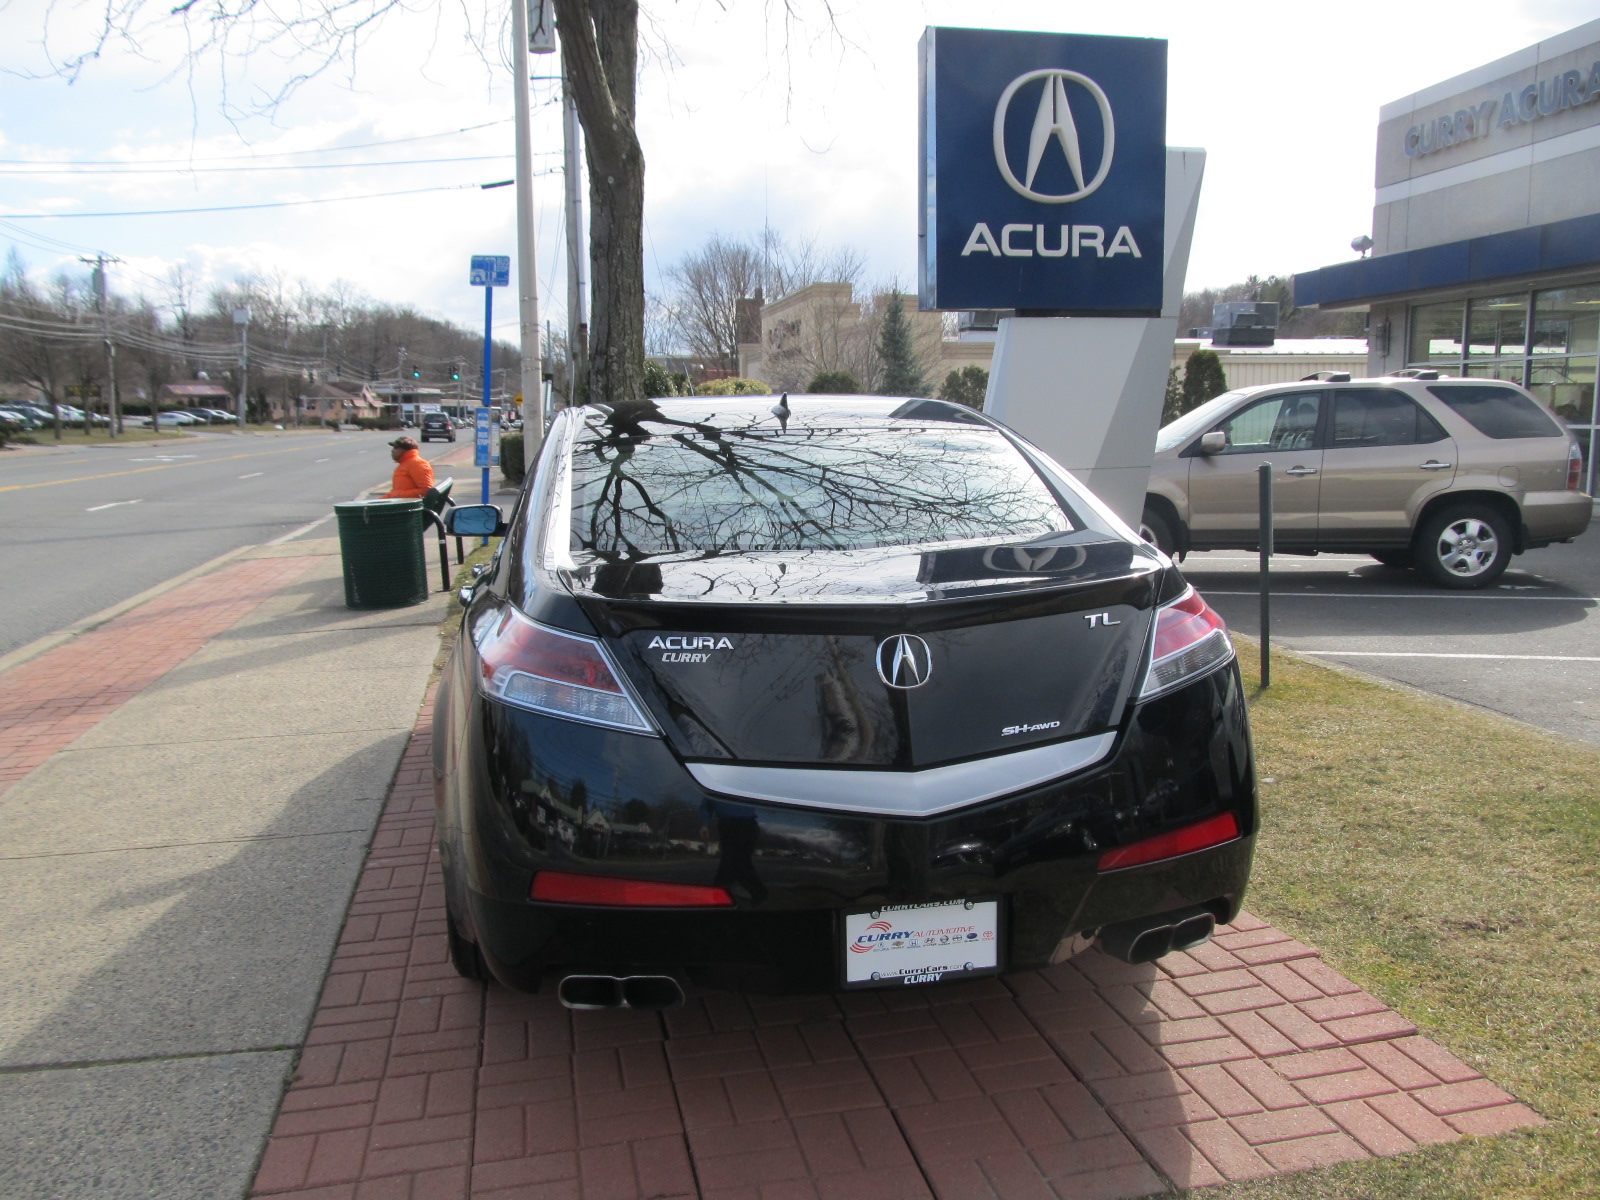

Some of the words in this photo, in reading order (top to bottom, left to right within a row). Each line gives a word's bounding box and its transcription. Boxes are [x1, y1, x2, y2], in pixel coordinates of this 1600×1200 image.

[1404, 100, 1491, 159] CURRY
[1496, 61, 1600, 130] ACURA
[960, 222, 1143, 258] ACURA
[1084, 612, 1121, 629] TL
[647, 635, 735, 650] ACURA
[661, 652, 711, 663] CURRY
[1001, 720, 1061, 737] SH-AWD
[857, 930, 915, 944] CURRY
[912, 926, 975, 938] AUTOMOTIVE
[903, 973, 943, 985] CURRY
